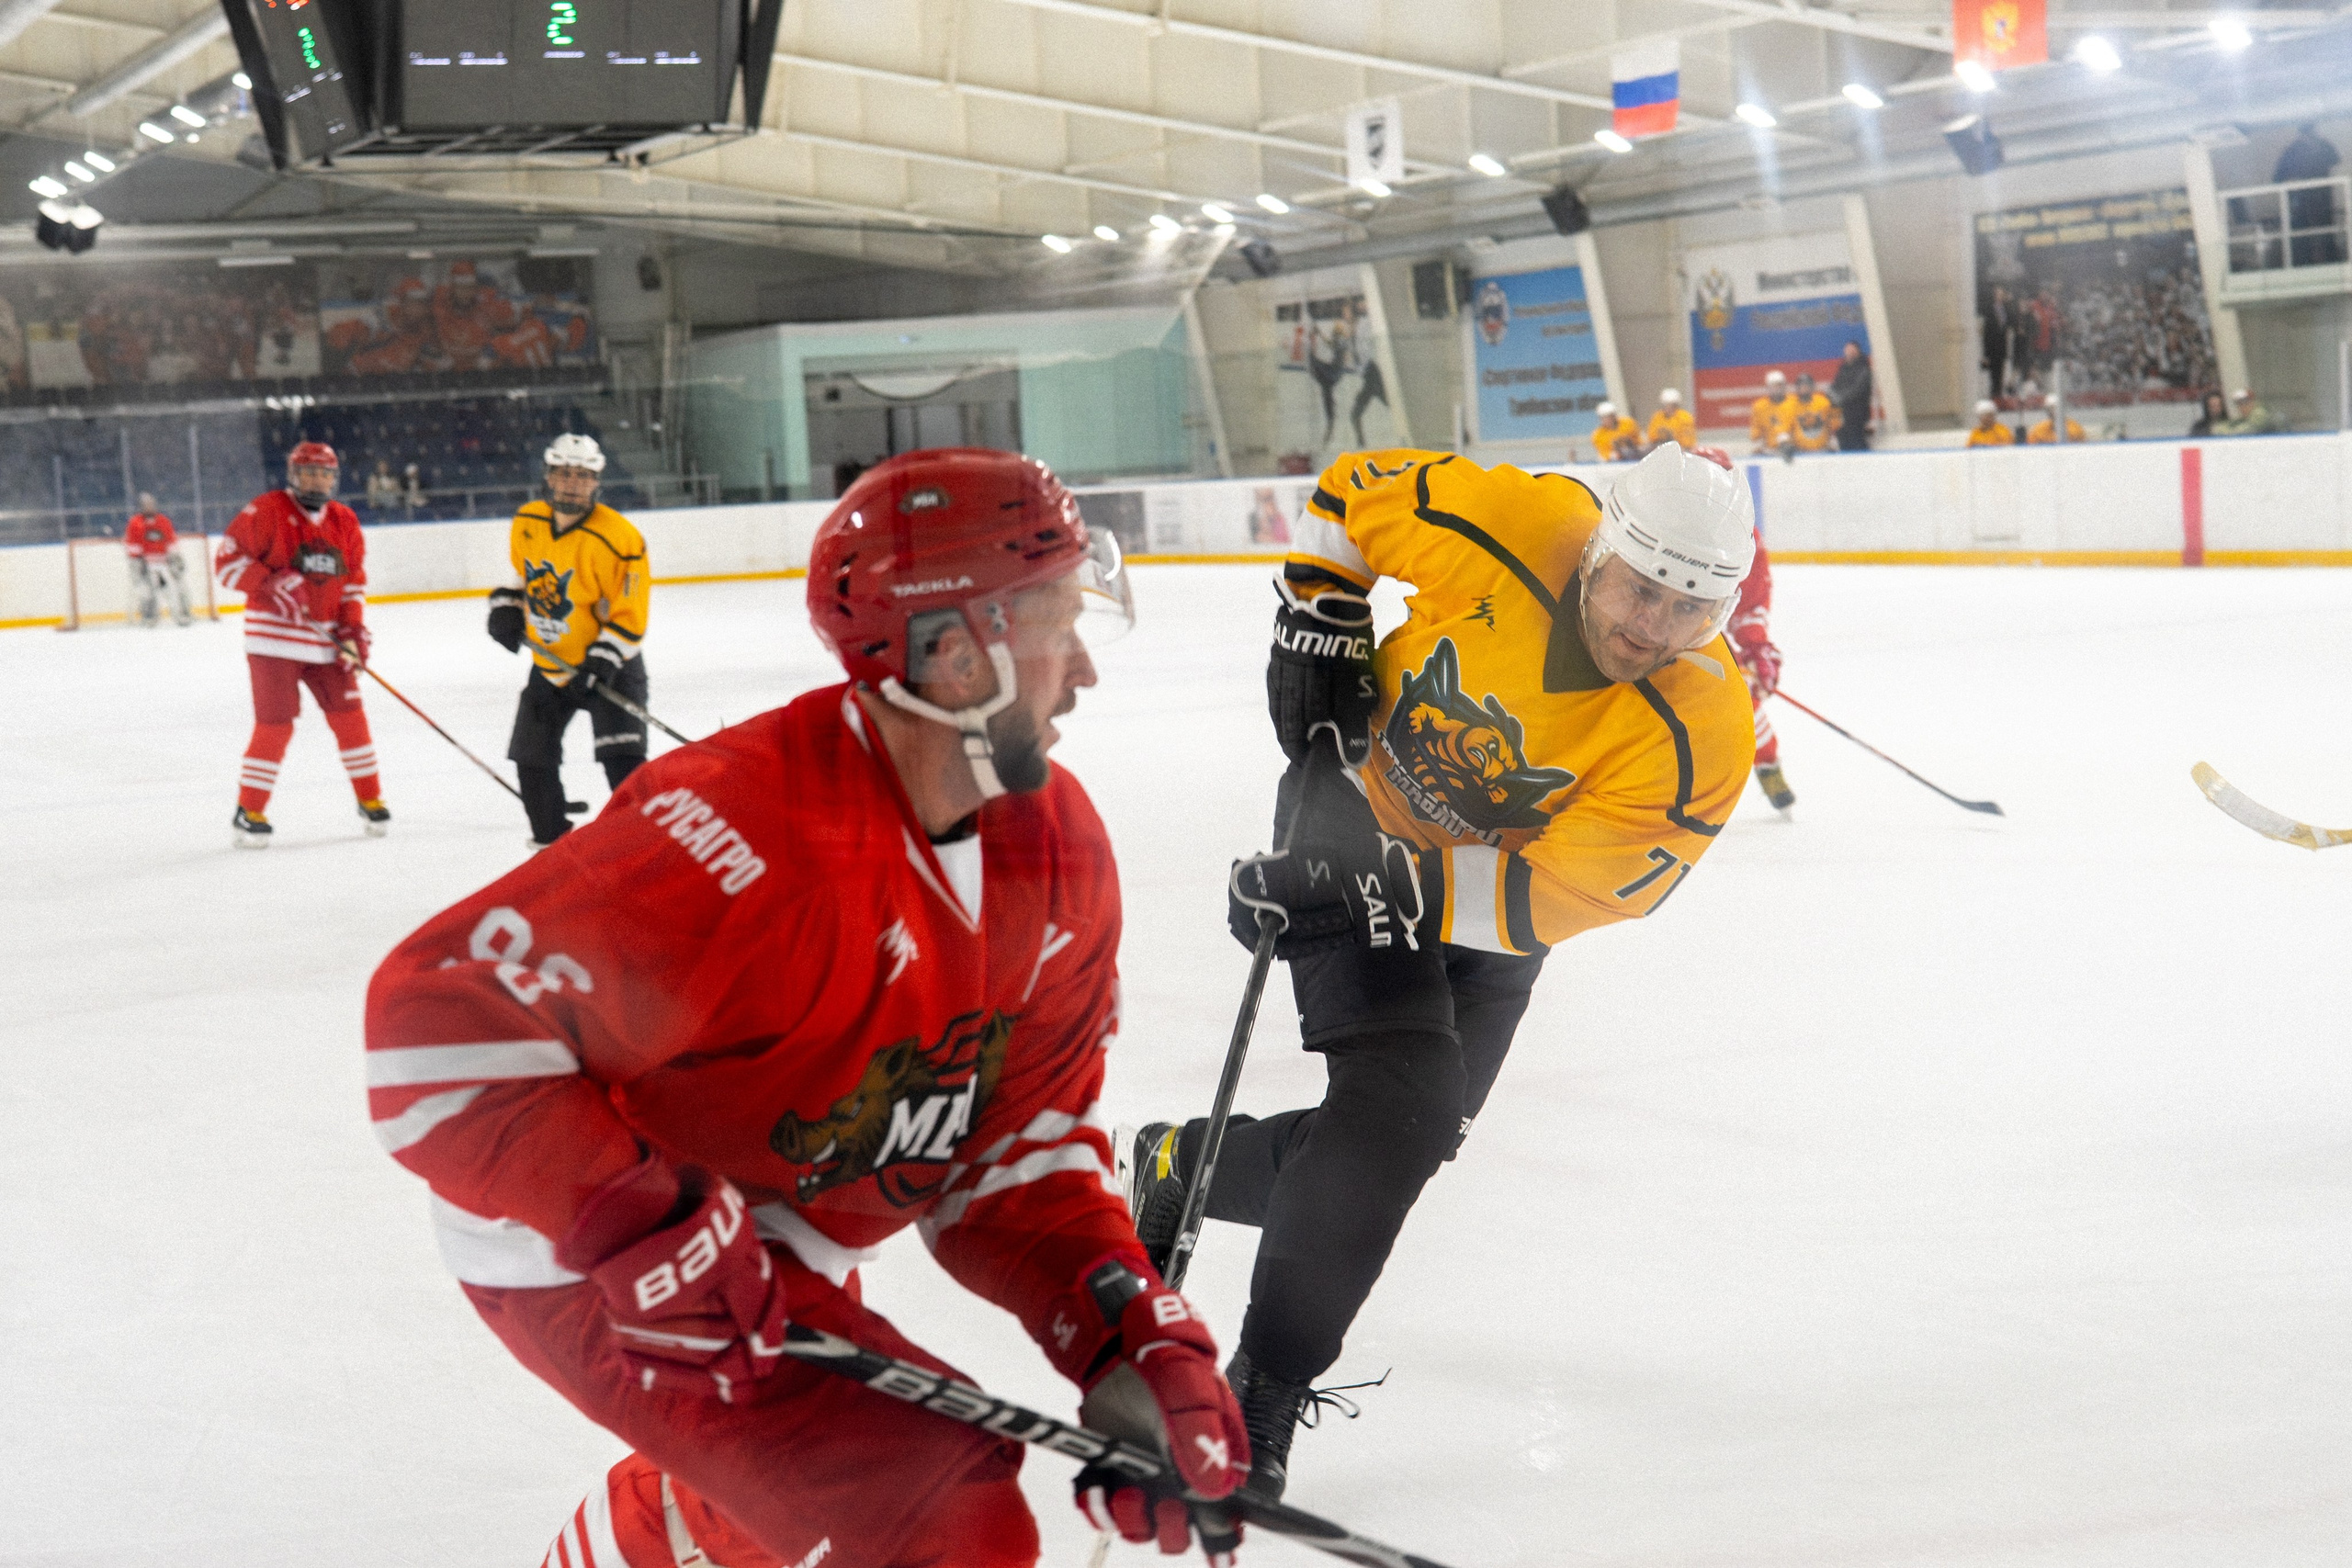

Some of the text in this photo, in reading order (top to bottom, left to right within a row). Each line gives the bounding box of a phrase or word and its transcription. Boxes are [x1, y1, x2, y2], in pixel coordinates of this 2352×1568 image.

[547, 2, 577, 45] 2
[890, 576, 973, 598] TACKLA
[1273, 620, 1369, 660] ALMING.
[641, 787, 767, 897] РУСАГРО
